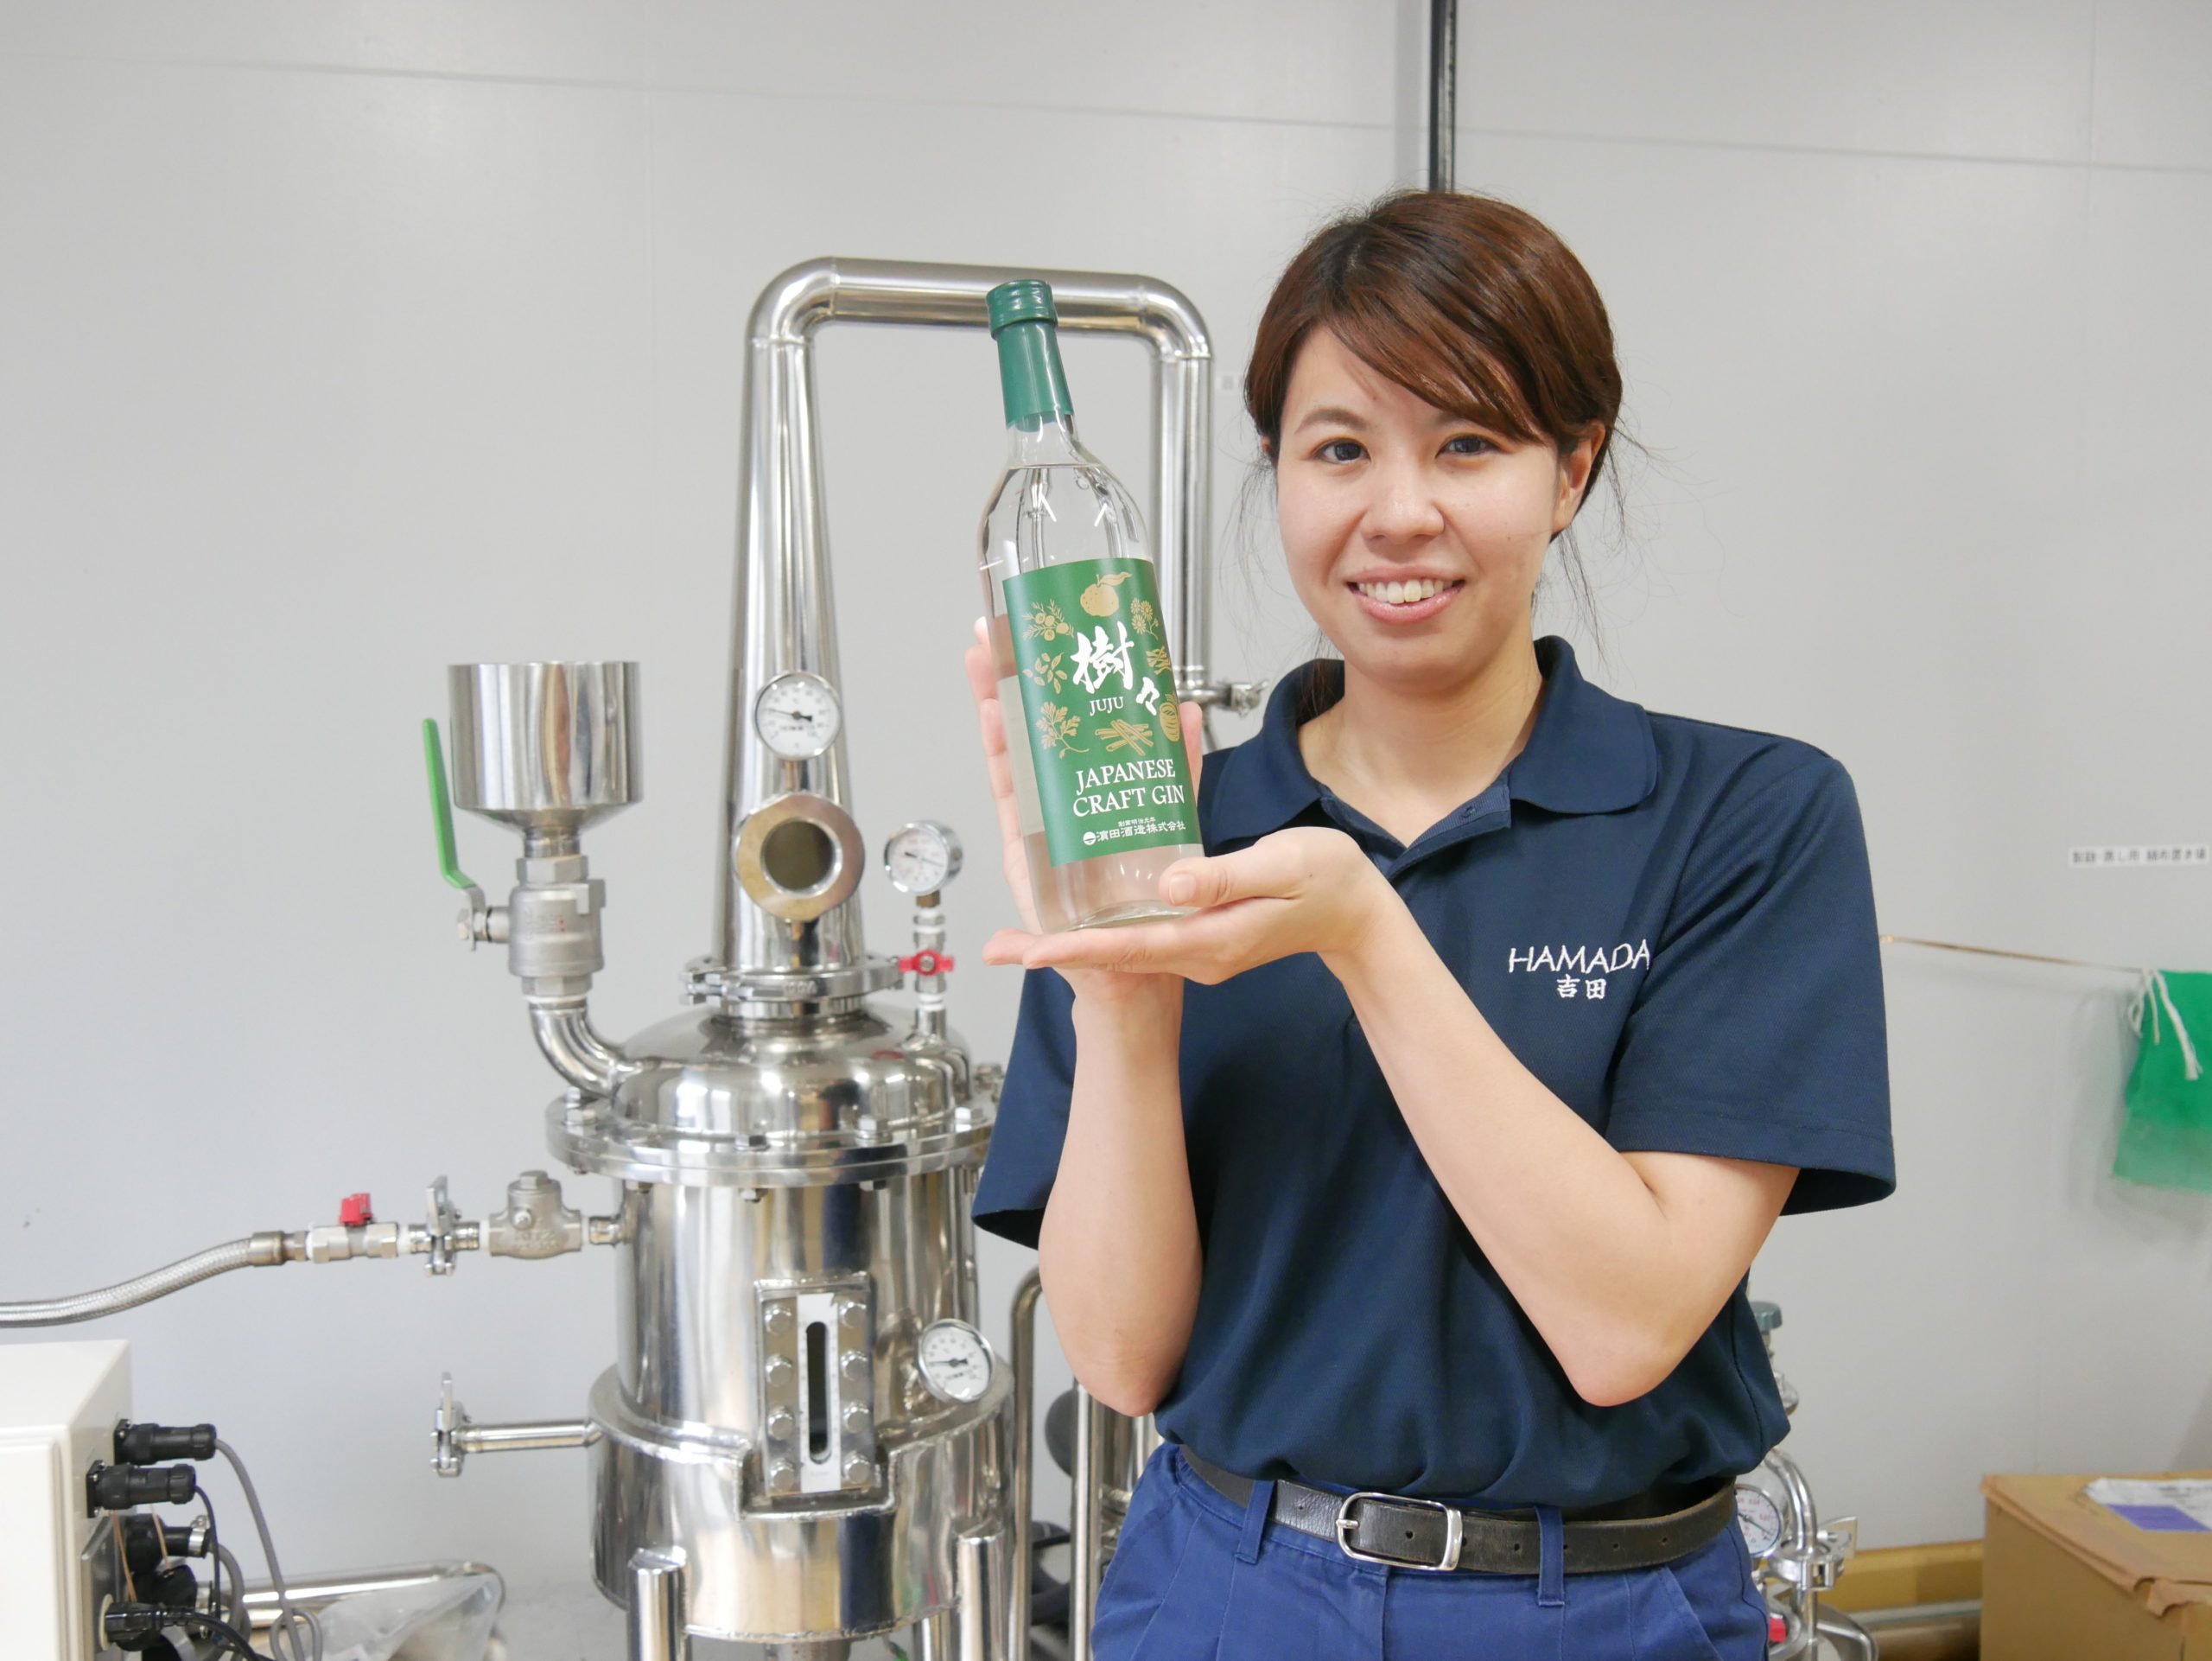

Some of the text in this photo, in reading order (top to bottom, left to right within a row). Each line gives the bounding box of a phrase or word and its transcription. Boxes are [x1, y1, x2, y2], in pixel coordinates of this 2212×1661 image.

[1089, 697, 1124, 716] JUJU
[1075, 759, 1176, 796] JAPANESE
[1072, 785, 1185, 818] CRAFT GIN
[1509, 939, 1650, 974] HAMADA
[1556, 973, 1607, 1000] 吉田
